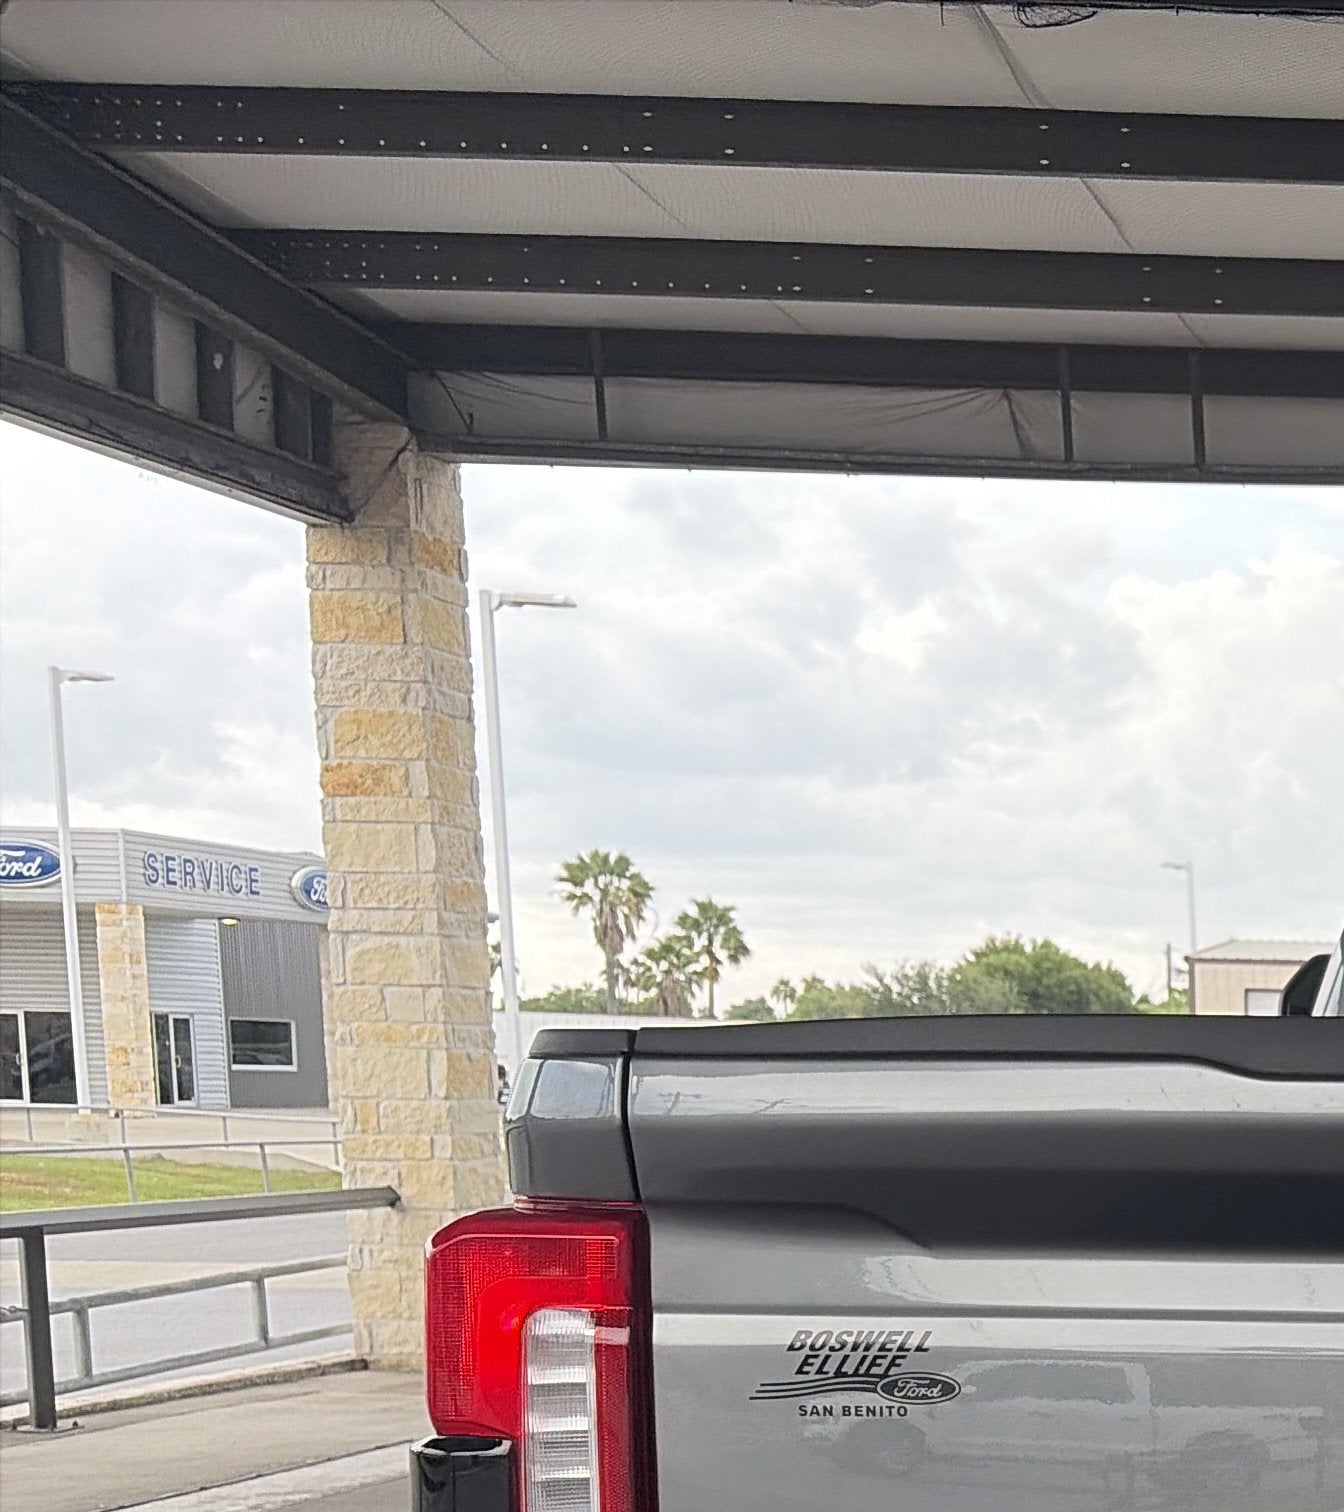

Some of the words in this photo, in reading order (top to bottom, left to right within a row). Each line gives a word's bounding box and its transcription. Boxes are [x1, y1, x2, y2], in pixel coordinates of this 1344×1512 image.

[0, 850, 43, 877] ord
[144, 851, 261, 897] SERVICE
[786, 1330, 933, 1353] BOSWELL
[794, 1354, 908, 1377] ELLIFF
[893, 1379, 943, 1398] Ford
[798, 1405, 834, 1417] SAN
[842, 1405, 908, 1417] BENITO
